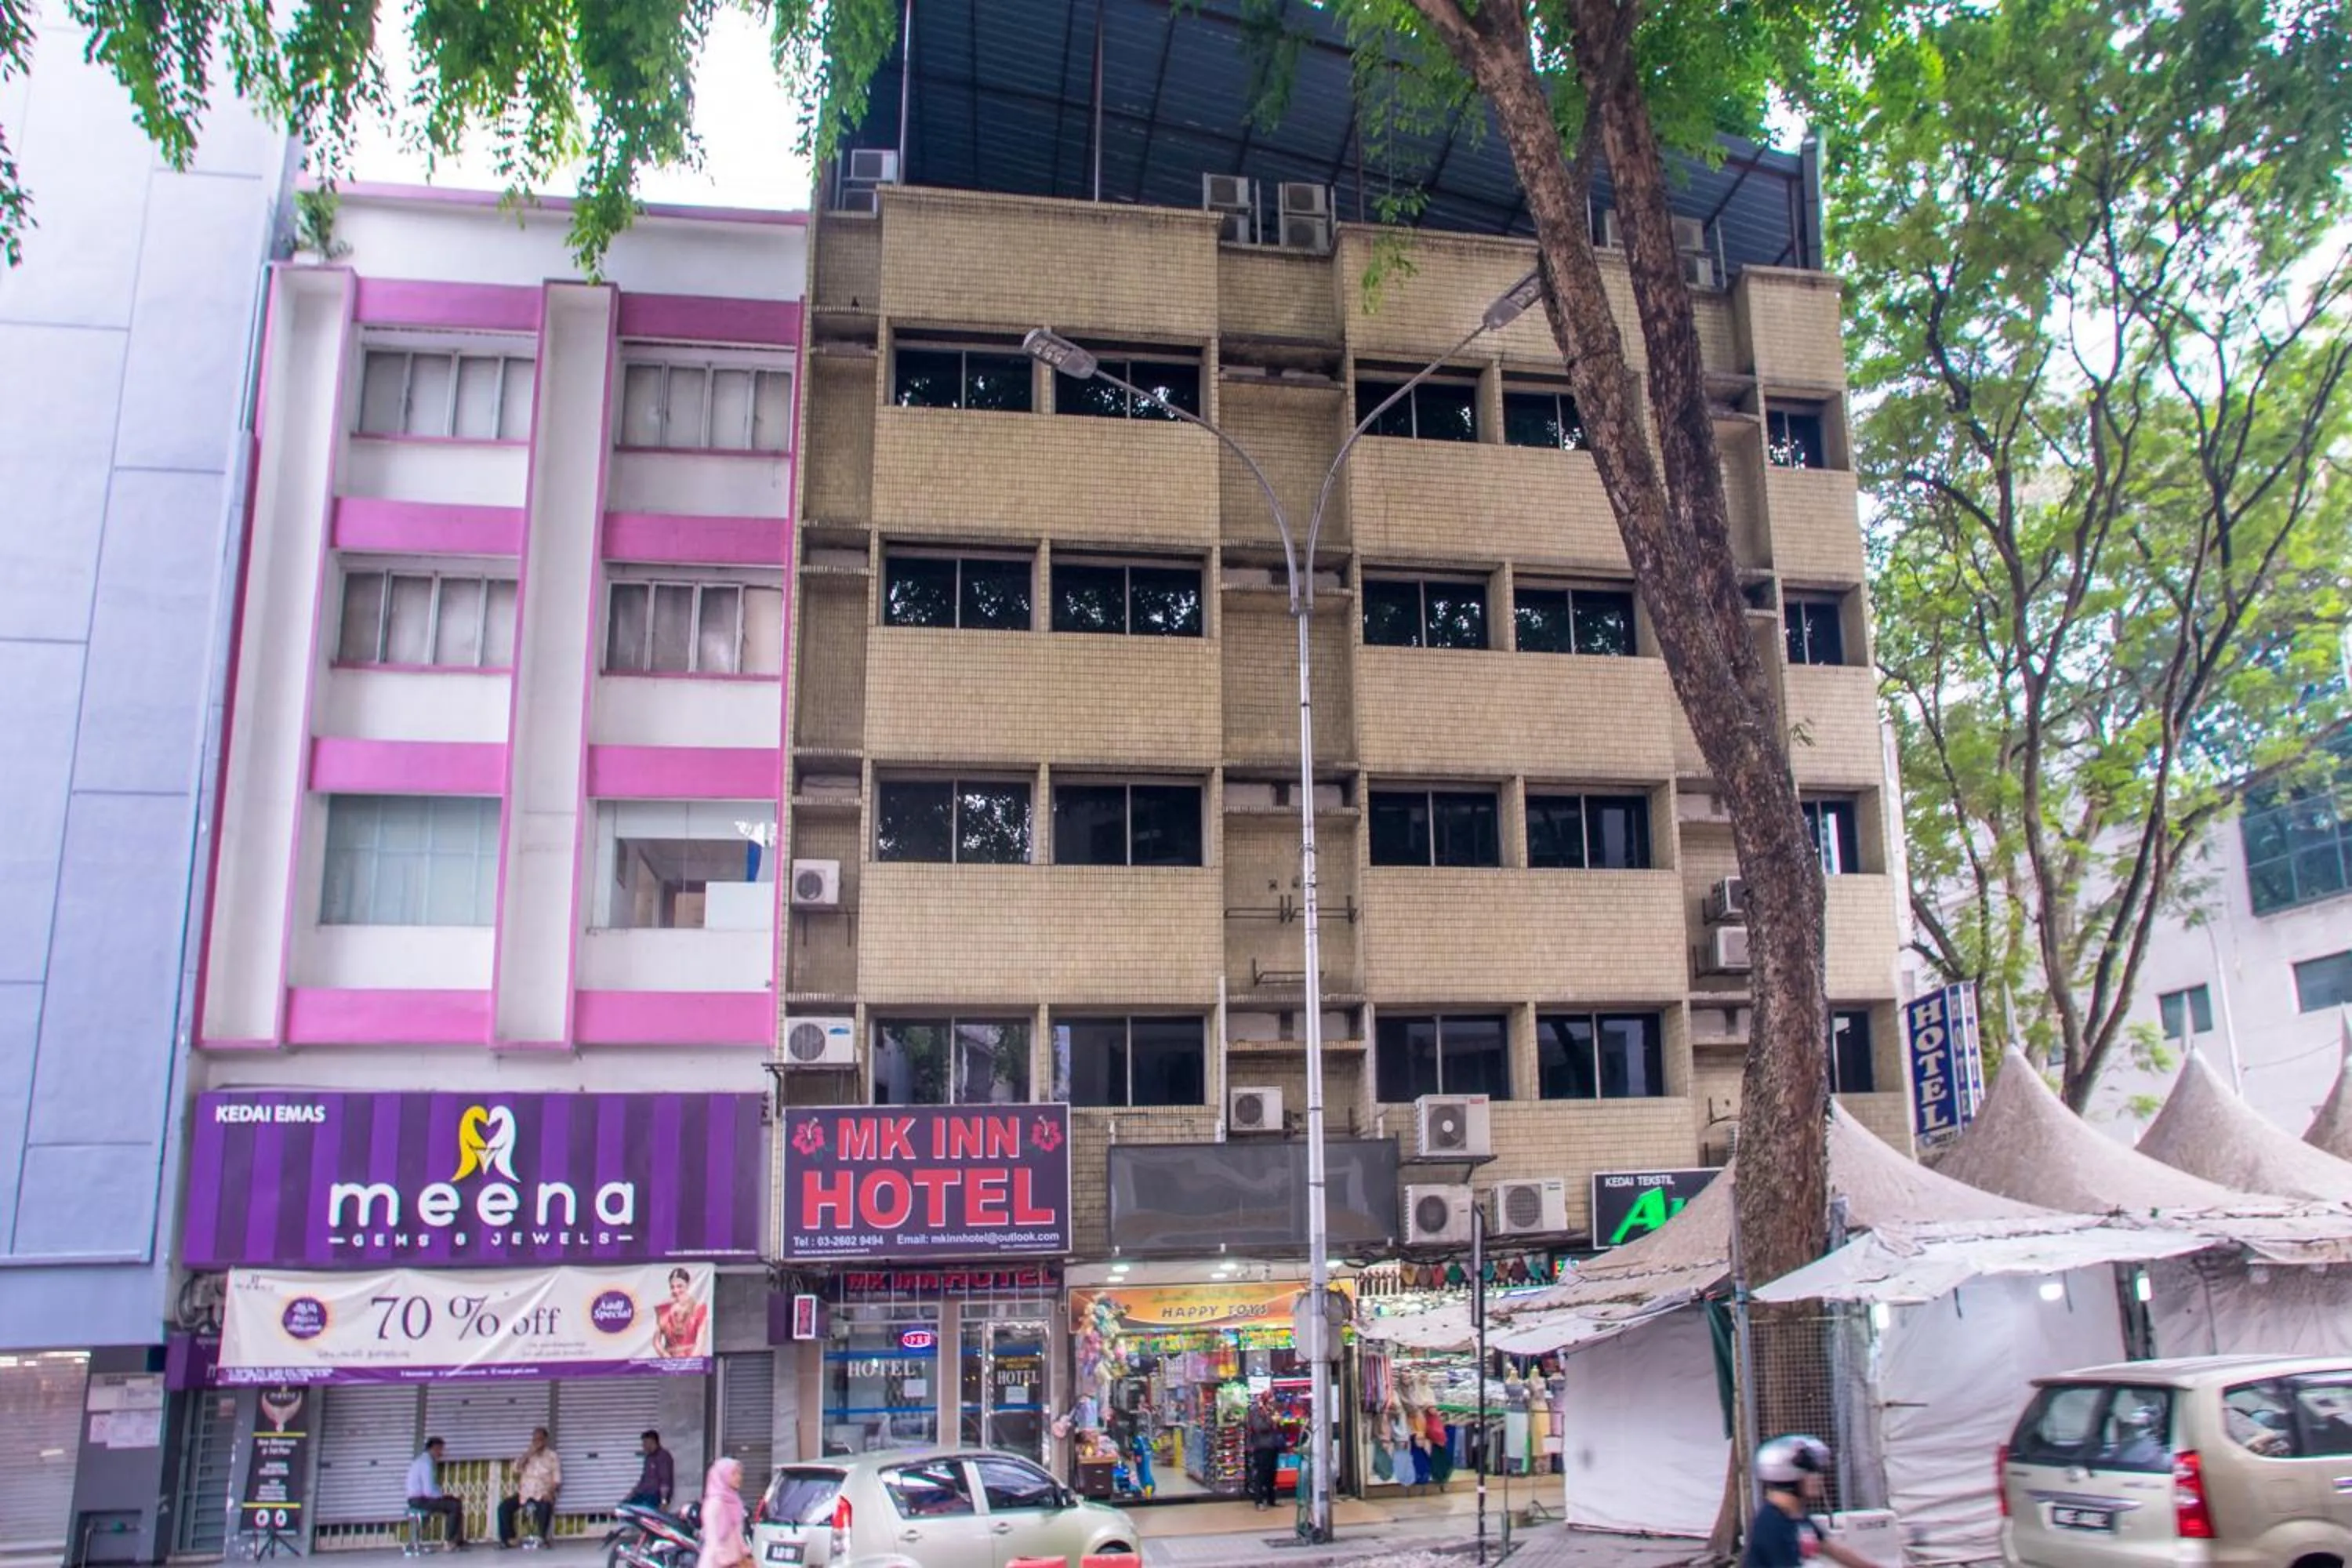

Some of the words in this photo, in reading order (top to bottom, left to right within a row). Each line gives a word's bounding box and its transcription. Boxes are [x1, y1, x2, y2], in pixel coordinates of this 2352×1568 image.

[1913, 999, 1947, 1130] HOTEL
[216, 1104, 272, 1123] KEDAI
[274, 1104, 326, 1123] EMAS
[837, 1116, 916, 1160] MK
[932, 1116, 1020, 1160] INN
[1605, 1177, 1634, 1187] KEDAI
[1637, 1175, 1675, 1185] TEKSTIL
[328, 1181, 635, 1228] meena
[802, 1168, 1055, 1230] HOTEL
[351, 1233, 430, 1247] GEMS
[490, 1232, 611, 1247] JEWELS
[371, 1295, 433, 1341] 70
[448, 1294, 501, 1341] %
[511, 1307, 561, 1337] off
[593, 1308, 632, 1322] Special
[1161, 1305, 1219, 1319] HAPPY
[848, 1359, 916, 1377] HOTEL
[996, 1370, 1041, 1385] HOTEL
